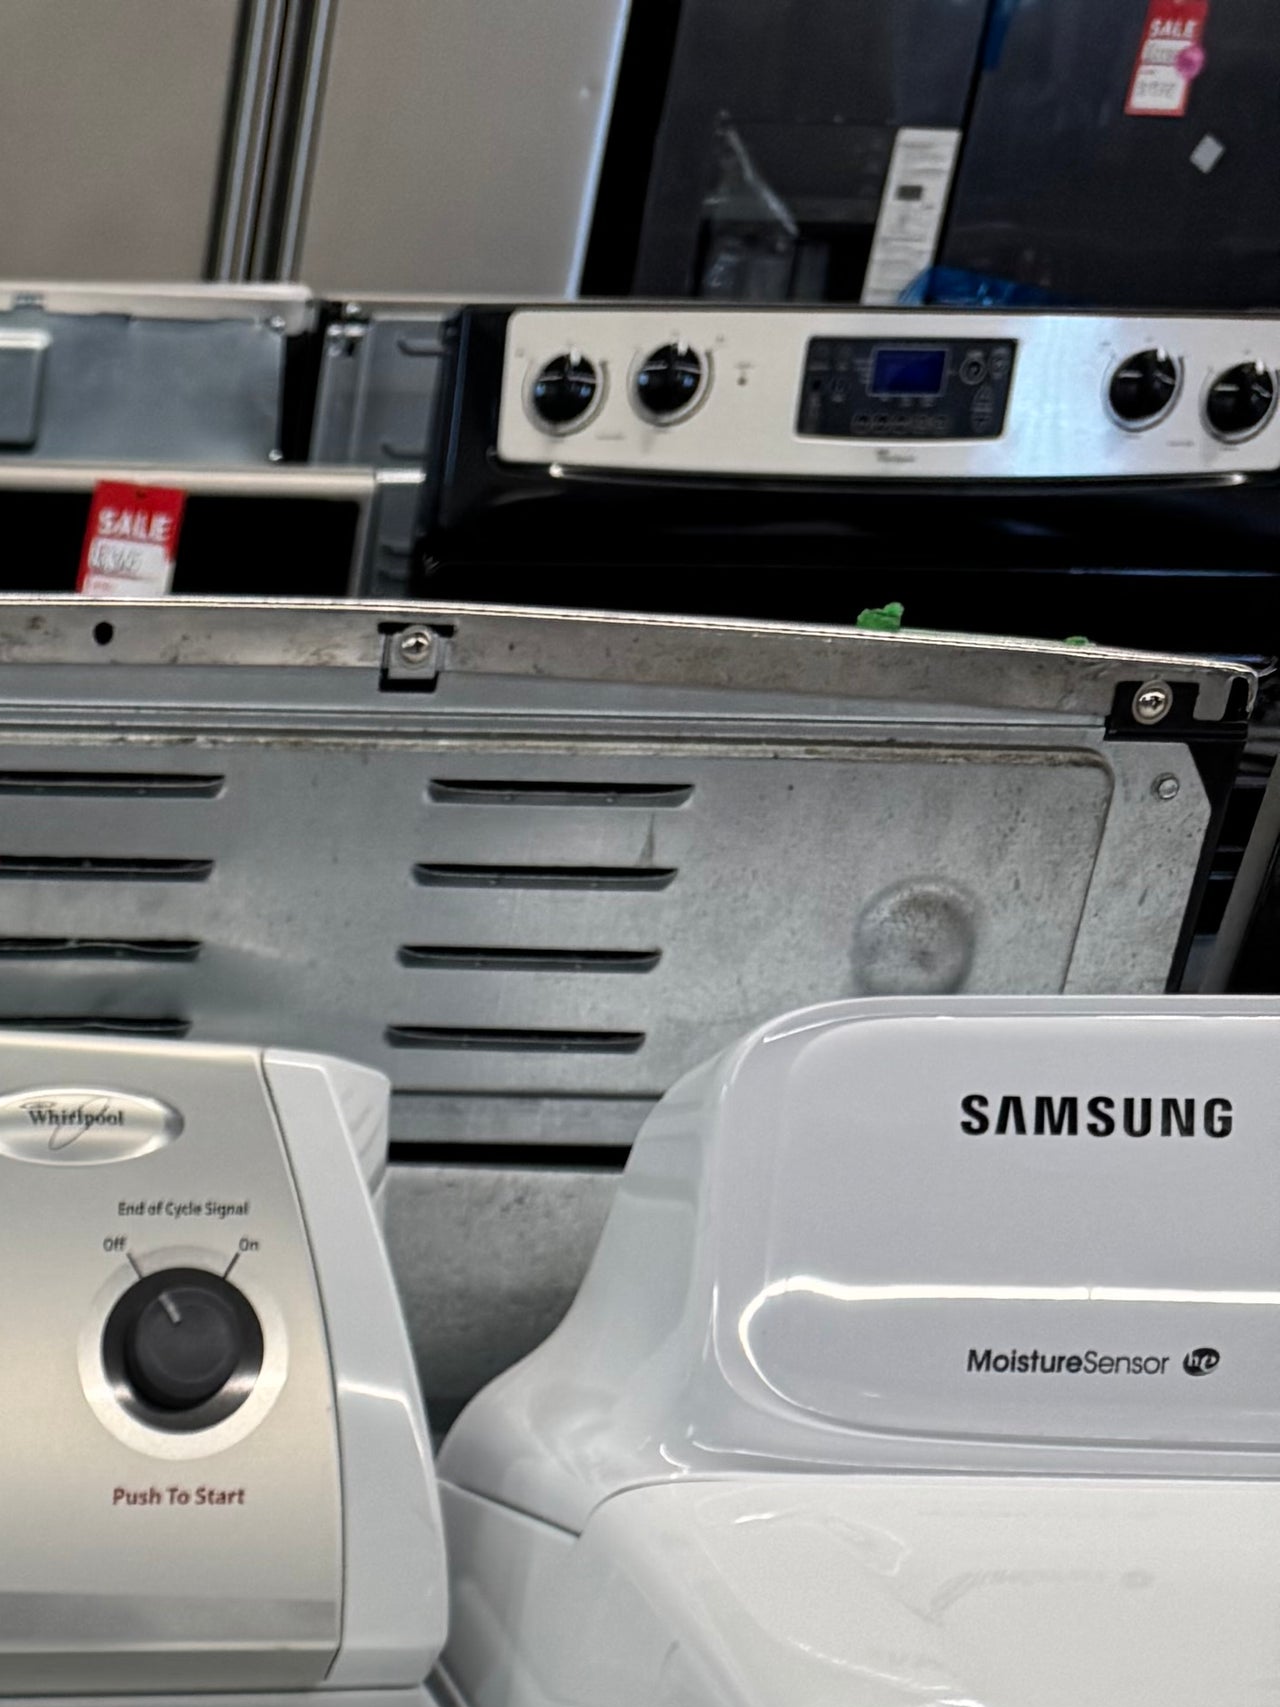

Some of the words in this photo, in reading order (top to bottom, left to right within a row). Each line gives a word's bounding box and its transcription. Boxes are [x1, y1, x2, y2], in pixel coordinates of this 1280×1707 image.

[98, 507, 171, 541] SALE
[27, 1104, 124, 1130] Whirlpool
[960, 1094, 1234, 1138] SAMSUNG
[117, 1202, 145, 1216] End
[147, 1202, 163, 1216] of
[165, 1202, 202, 1219] Cycle
[204, 1202, 249, 1219] Signal
[102, 1236, 127, 1252] Off
[238, 1237, 259, 1252] On
[966, 1348, 1170, 1375] MoistureSensor
[112, 1486, 162, 1506] Push
[166, 1486, 190, 1506] To
[194, 1486, 246, 1506] Start
